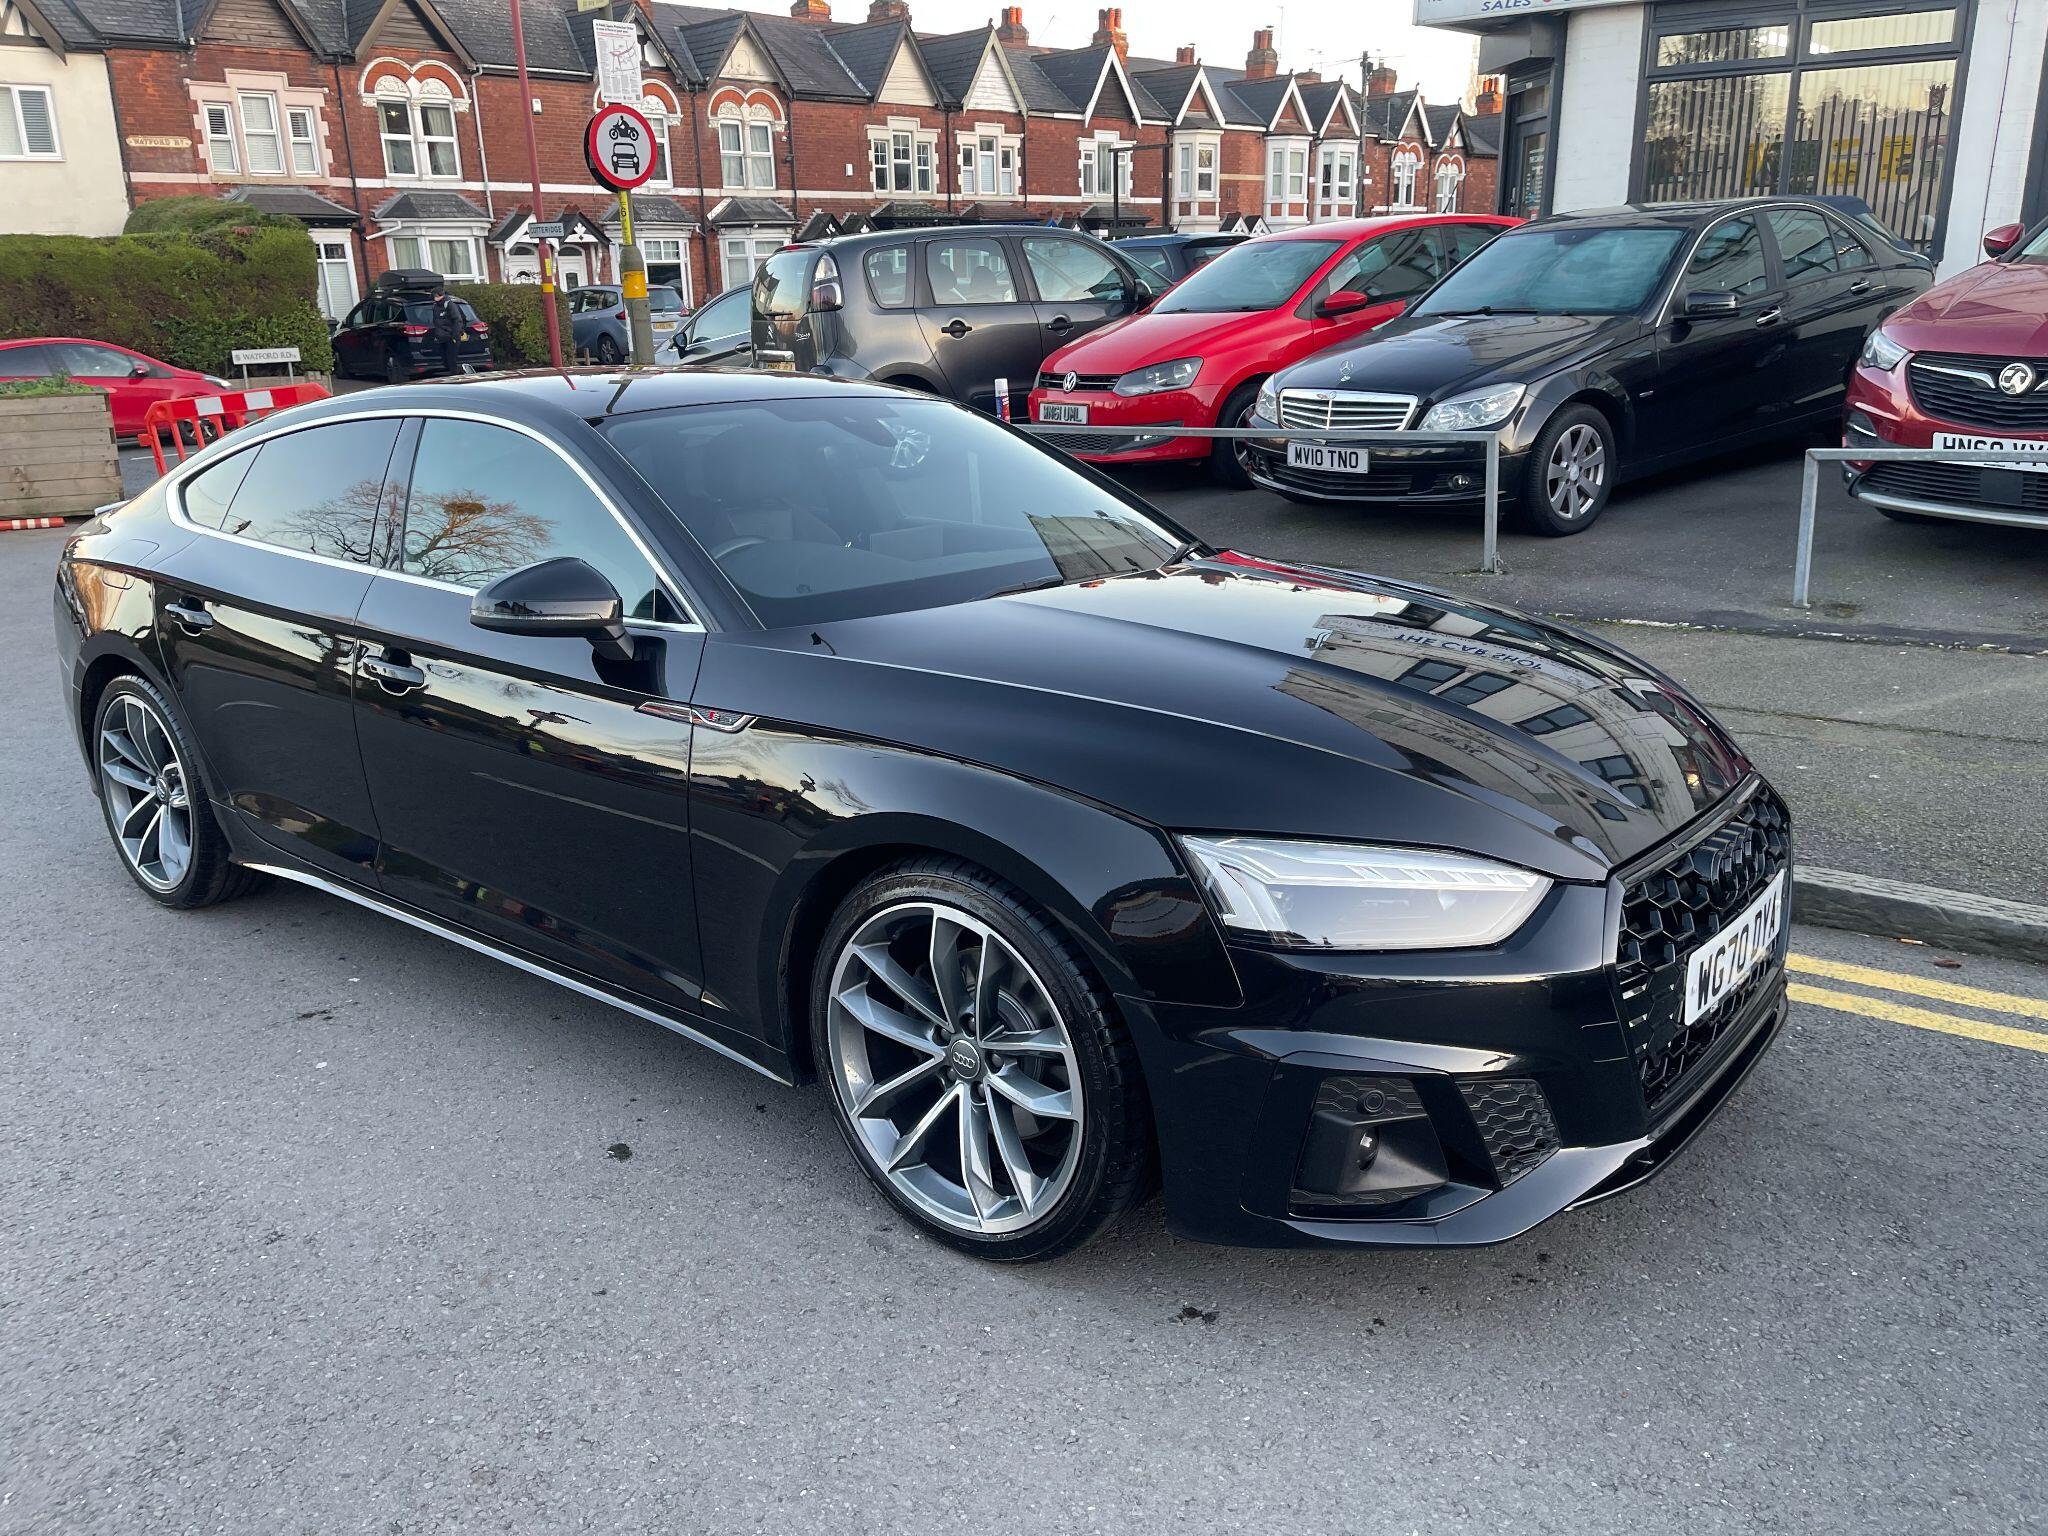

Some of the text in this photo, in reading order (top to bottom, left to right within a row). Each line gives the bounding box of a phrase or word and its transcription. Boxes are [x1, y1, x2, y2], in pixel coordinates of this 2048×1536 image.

[1481, 0, 1531, 12] SALES
[242, 352, 279, 360] WATFORD
[1295, 446, 1359, 469] MV10 TNO
[1697, 923, 1749, 1011] WG70
